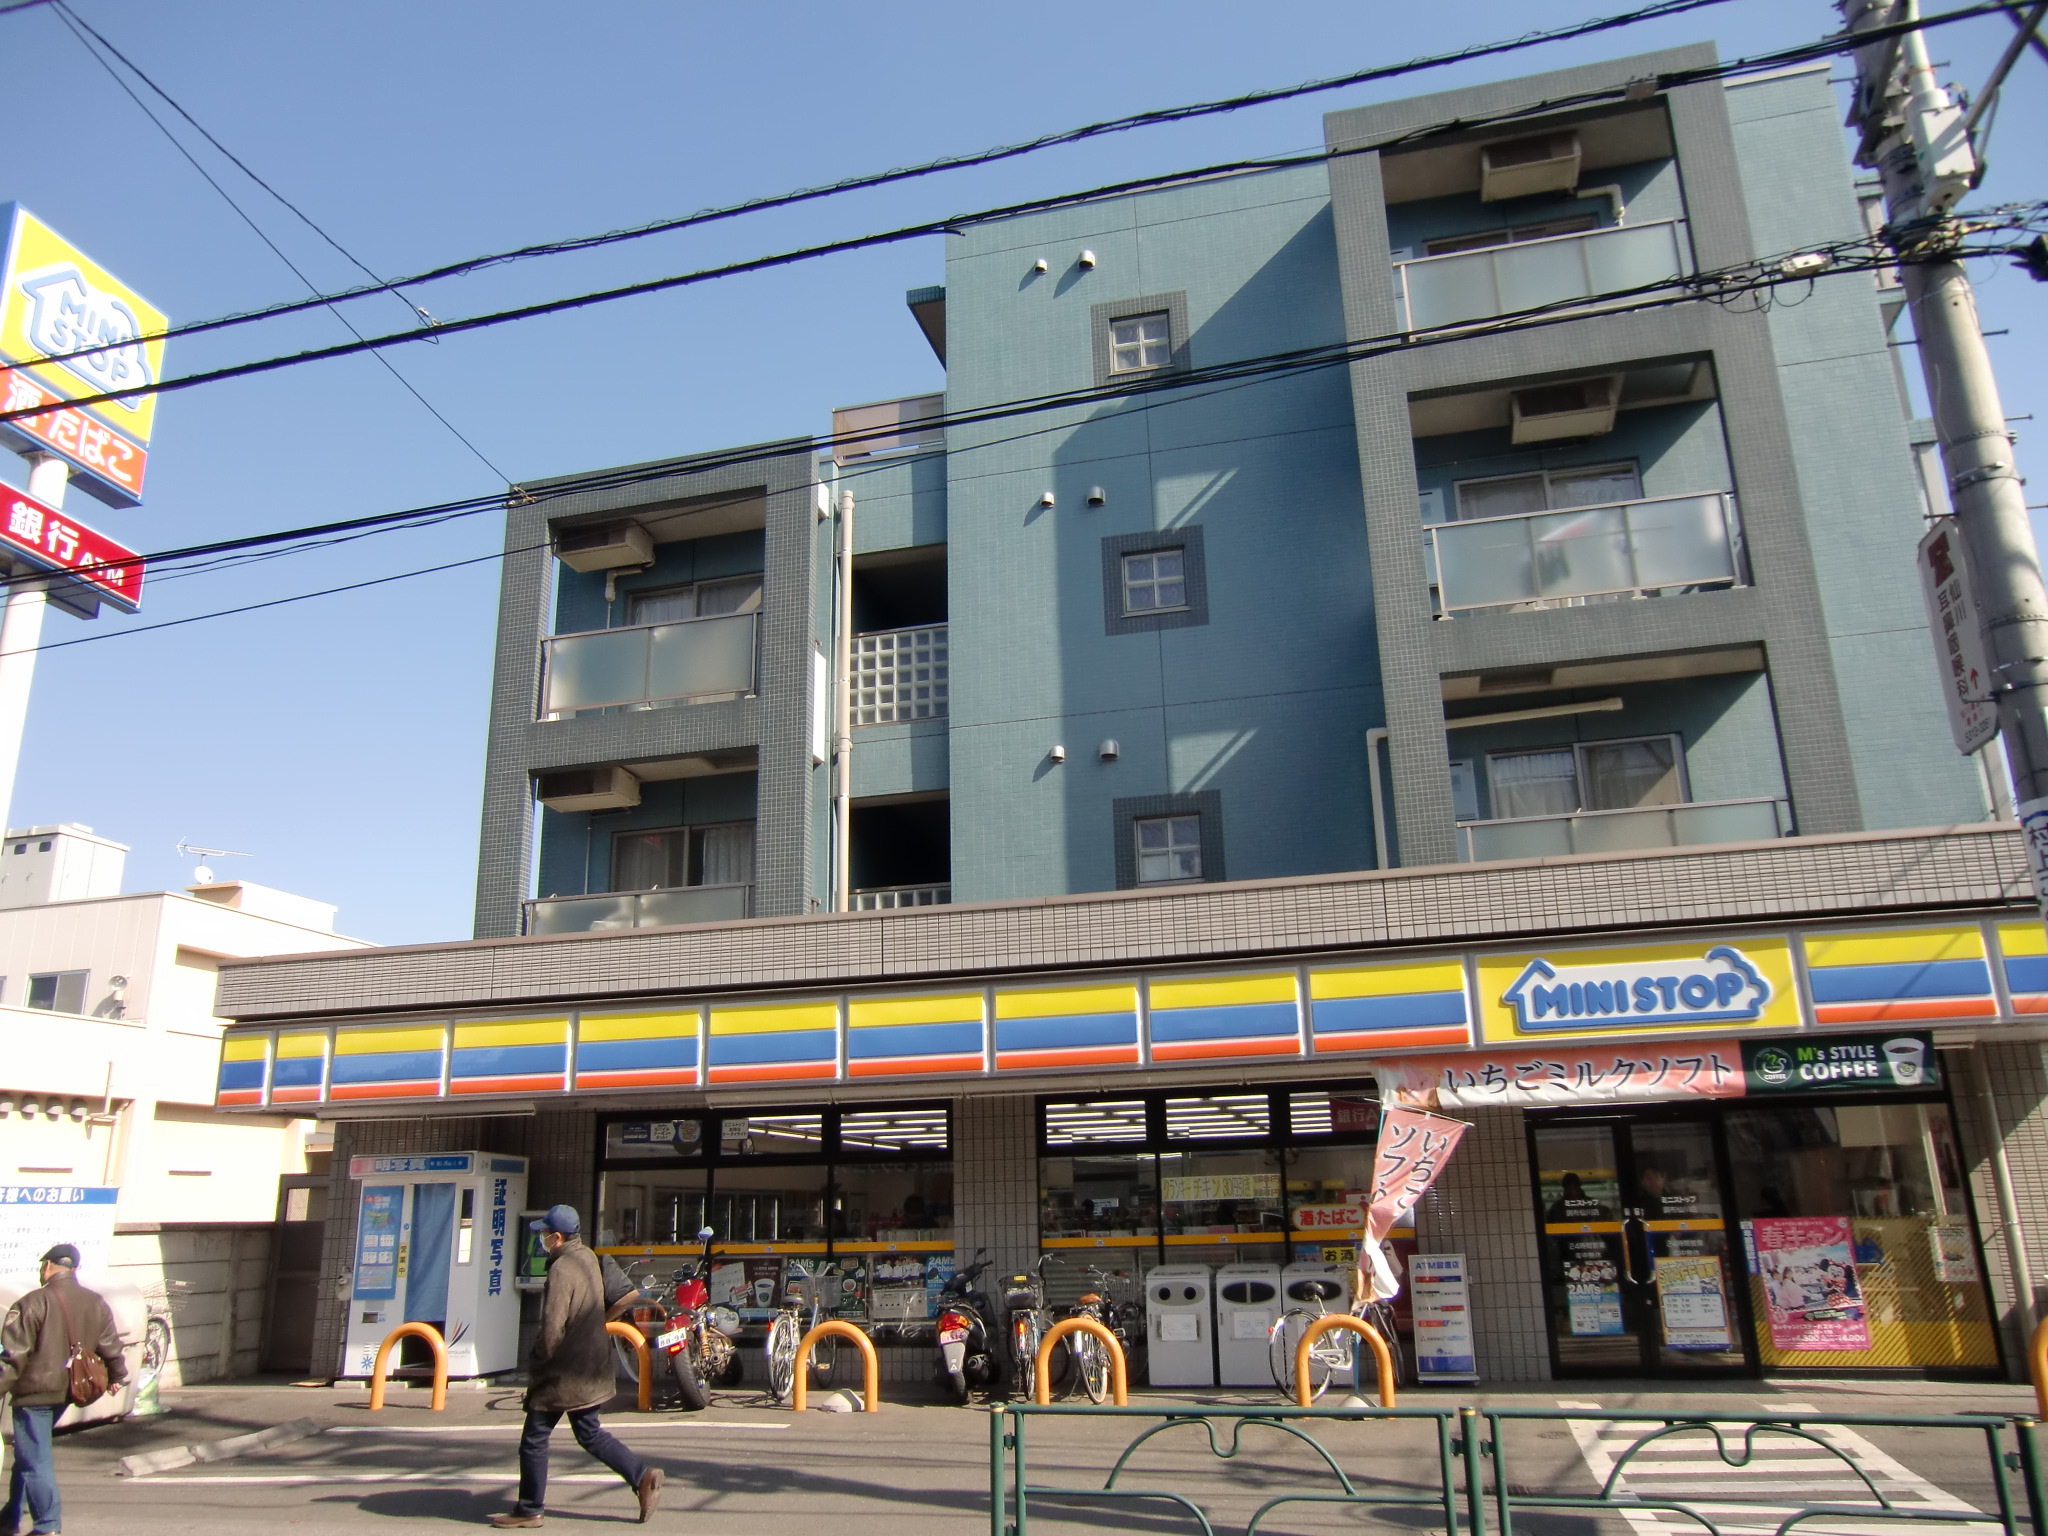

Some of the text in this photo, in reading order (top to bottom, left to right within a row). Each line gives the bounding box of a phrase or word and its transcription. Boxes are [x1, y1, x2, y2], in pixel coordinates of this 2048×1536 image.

[61, 291, 128, 356] MINI
[50, 318, 129, 382] STOP
[9, 501, 79, 560] 銀行
[1533, 972, 1744, 1017] MINISTOP
[1798, 1045, 1875, 1061] M's STYLE
[1446, 1054, 1732, 1094] いちごミルクソフト
[1800, 1061, 1879, 1081] COFFEE
[1565, 1199, 1598, 1207] ミニストップ
[1300, 1208, 1359, 1226] 酒・たばこ
[488, 1179, 508, 1296] 証明写真
[1762, 1226, 1843, 1248] 春キャン
[399, 1245, 407, 1274] 営業中
[1659, 1265, 1697, 1285] STAFF
[1568, 1283, 1600, 1295] 2AM's
[660, 1333, 685, 1346] 88-94
